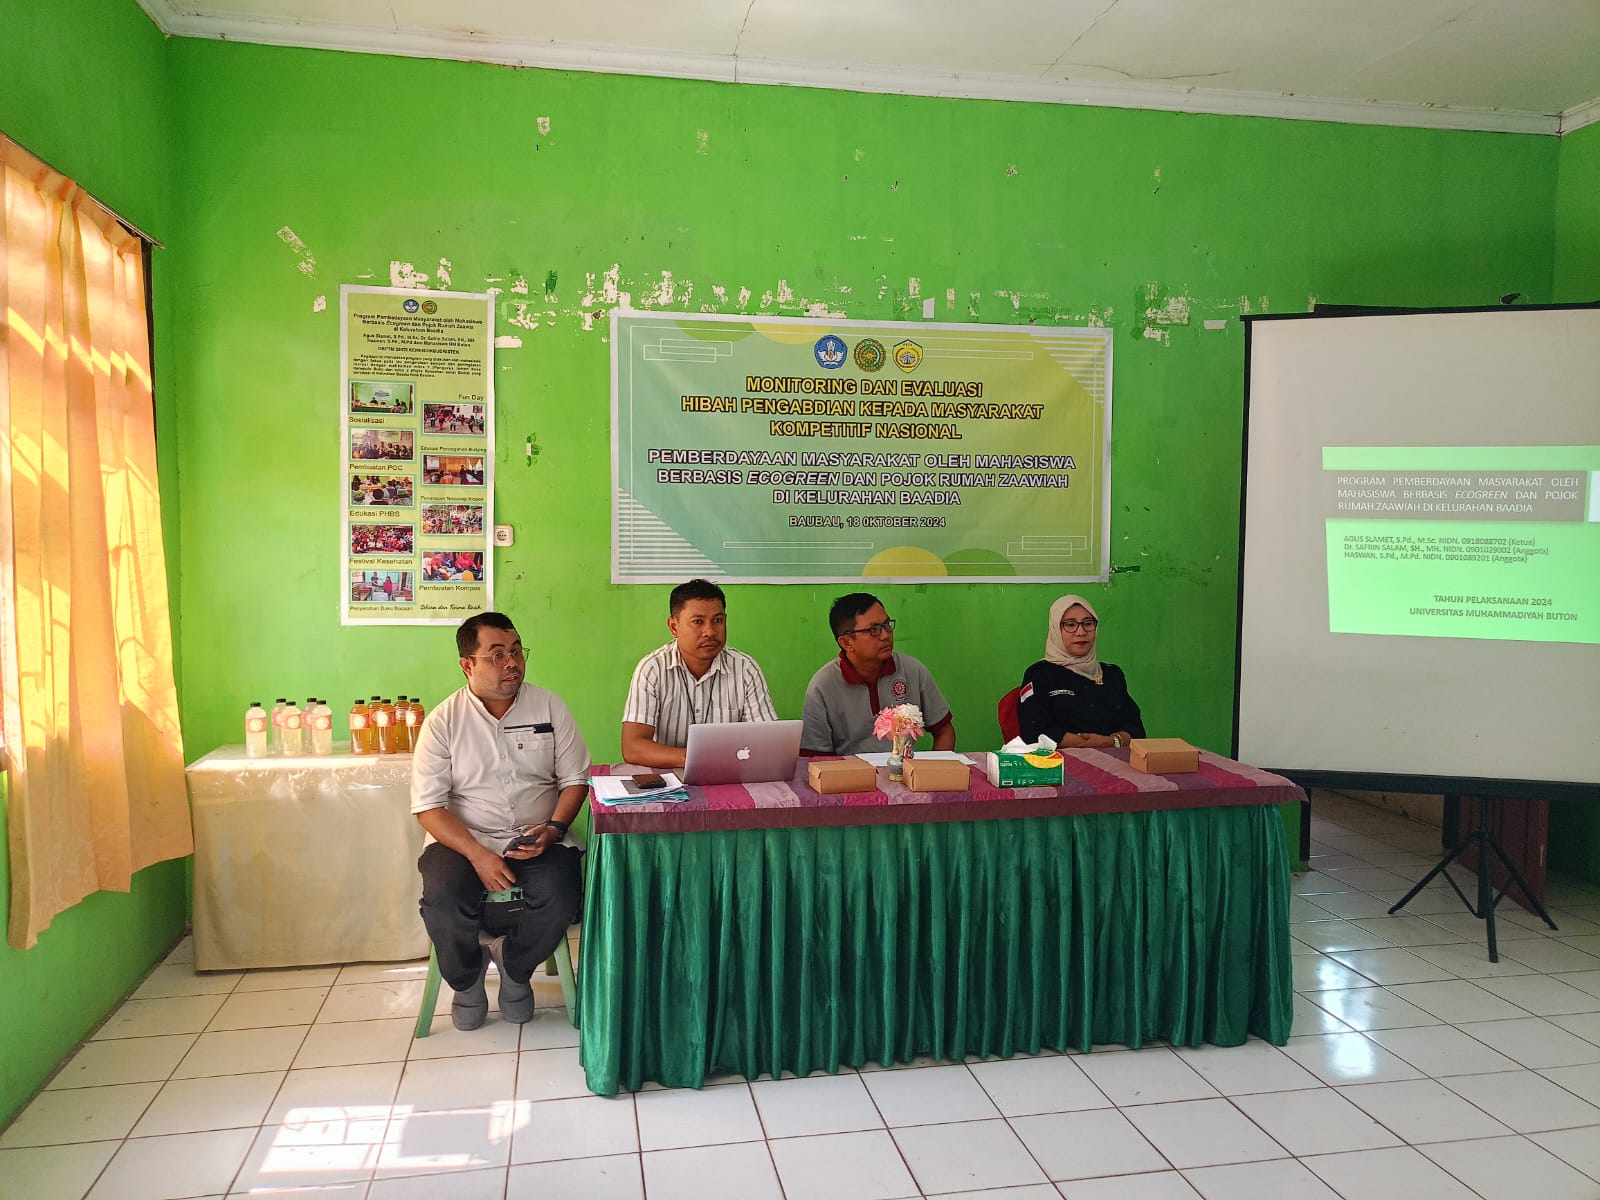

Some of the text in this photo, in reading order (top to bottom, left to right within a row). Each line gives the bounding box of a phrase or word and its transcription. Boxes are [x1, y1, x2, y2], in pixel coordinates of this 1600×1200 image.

[746, 376, 983, 398] MONITORING DAN EVALUASI
[458, 393, 484, 402] Fun Day
[681, 396, 1044, 420] HIBAH PENGABDIAN KEPADA MASYARAKAT
[348, 416, 385, 424] Sosialisasi
[770, 421, 962, 439] KOMPETITIF NASIONAL
[648, 449, 1076, 469] PEMBERDAYAAN MASYARAKAT OLEH MAHASISWA
[657, 469, 1069, 488] BERBASIS ECOGREEN DAN POJOK RUMAH ZAAWIAH
[1337, 477, 1578, 487] PROGRAM PEMBERDAYAAN MASYARAKAT OLEH
[773, 490, 961, 505] DI KELURAHAN BAADIA
[1337, 489, 1578, 500] MAHASISWA BERBASIS ECOGREEN DAN POJOK
[1338, 502, 1533, 512] RUMAH ZAAWIAH DI KELURAHAN BAADIA
[789, 516, 844, 529] BAUBAU,
[847, 516, 860, 527] 18
[920, 517, 946, 528] 2024
[1434, 594, 1553, 606] TAHUN PELAKSANAAN 2024
[1409, 607, 1578, 621] UNIVERSITAS MUHAMMADIYAH BUTON
